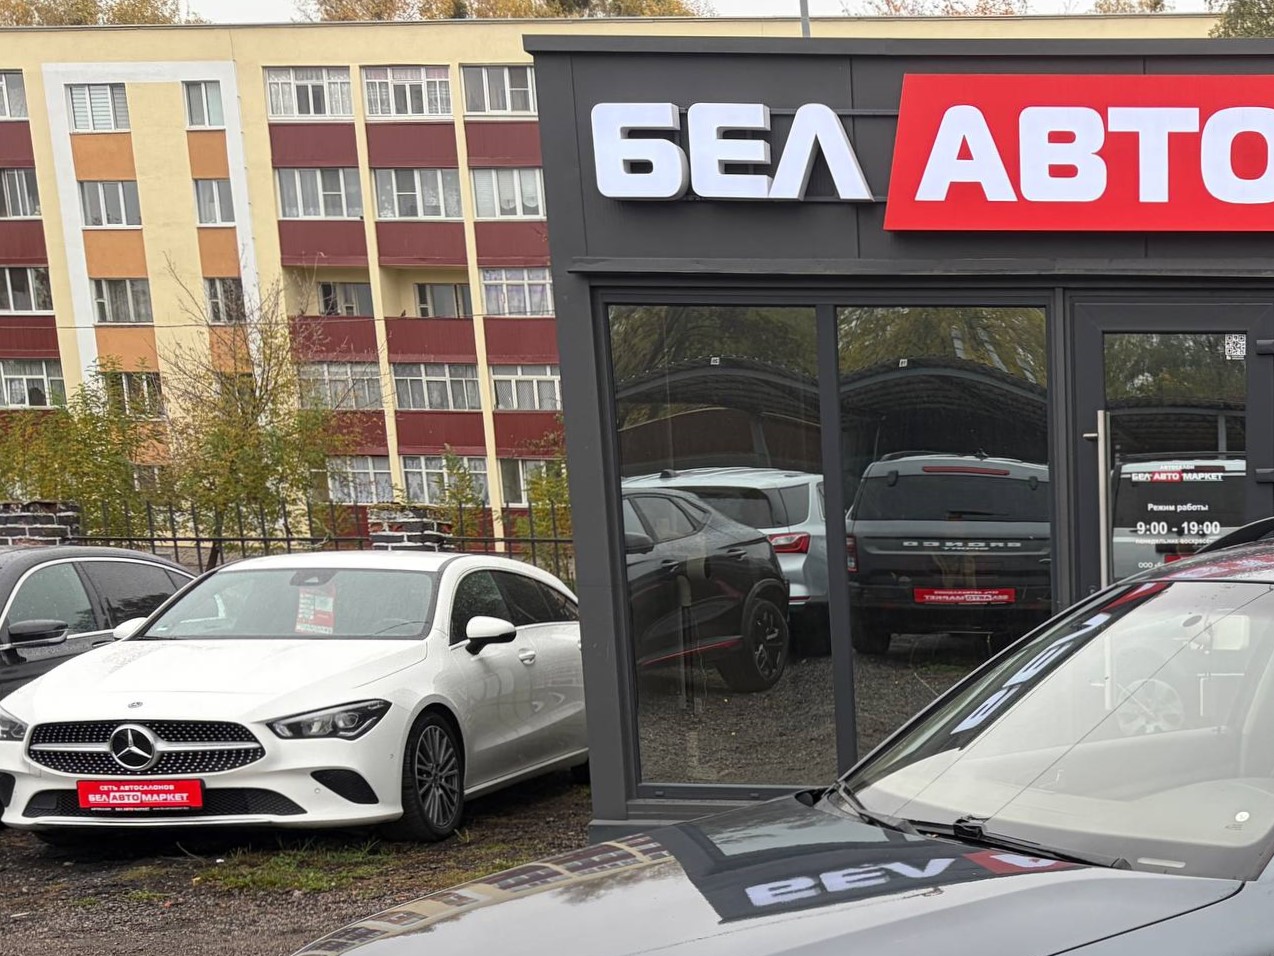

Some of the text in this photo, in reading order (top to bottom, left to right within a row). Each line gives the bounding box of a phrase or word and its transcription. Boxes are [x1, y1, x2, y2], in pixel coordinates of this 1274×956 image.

[591, 102, 875, 201] БЕЛ
[1132, 473, 1150, 481] БЕЛ
[1182, 473, 1223, 481] МАРКЕТ
[1147, 503, 1208, 512] Режим работы
[1136, 521, 1168, 534] 9:00
[1182, 521, 1220, 534] 19:00
[88, 794, 108, 802] БЕЛ
[141, 793, 189, 801] МАРКЕТ
